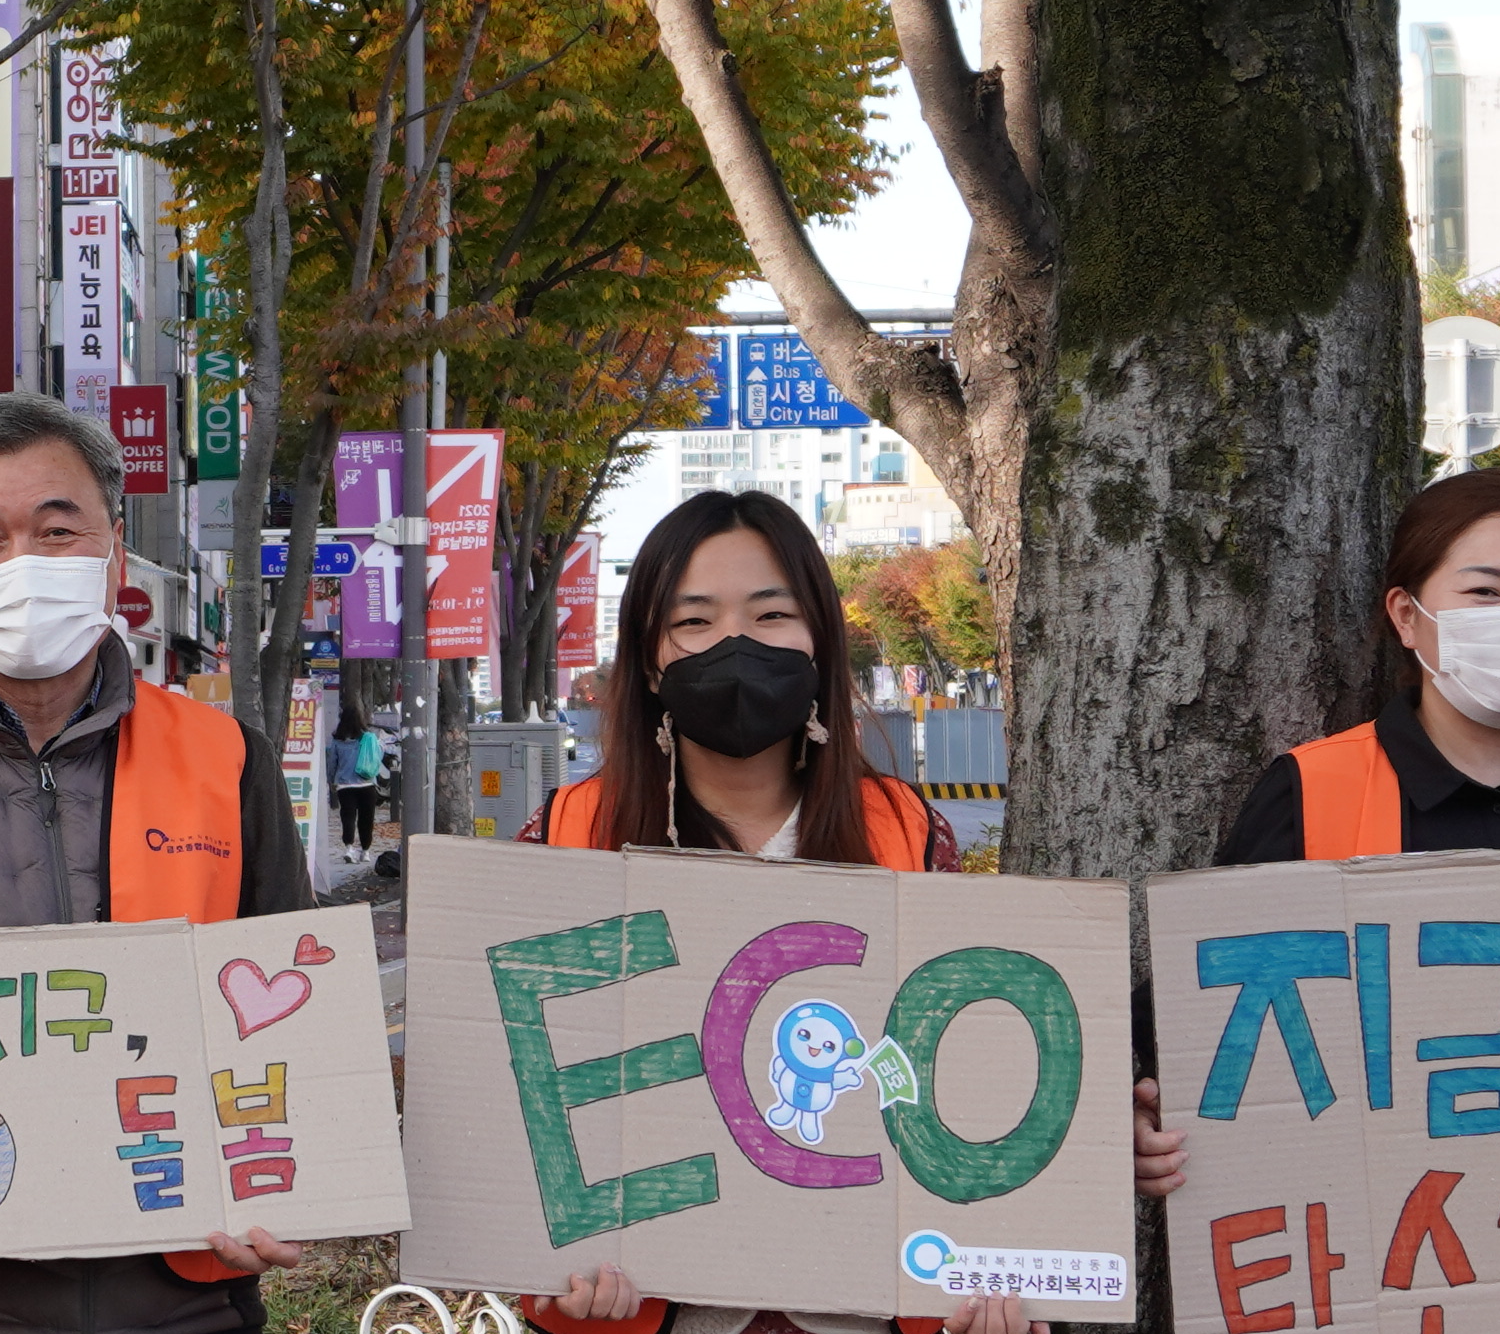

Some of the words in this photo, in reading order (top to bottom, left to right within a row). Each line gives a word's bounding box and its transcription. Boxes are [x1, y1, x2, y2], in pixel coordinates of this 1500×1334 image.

[70, 214, 106, 235] JEI
[773, 365, 801, 379] Bus
[770, 380, 816, 404] 시청
[770, 406, 804, 424] City
[808, 405, 839, 421] Hall
[122, 446, 164, 458] OLLYS
[123, 461, 164, 473] OFFEE
[335, 551, 350, 565] 99
[485, 909, 1084, 1249] ECO
[115, 1061, 297, 1213] 돌봄
[946, 1269, 1124, 1297] 금호종합사회복지관
